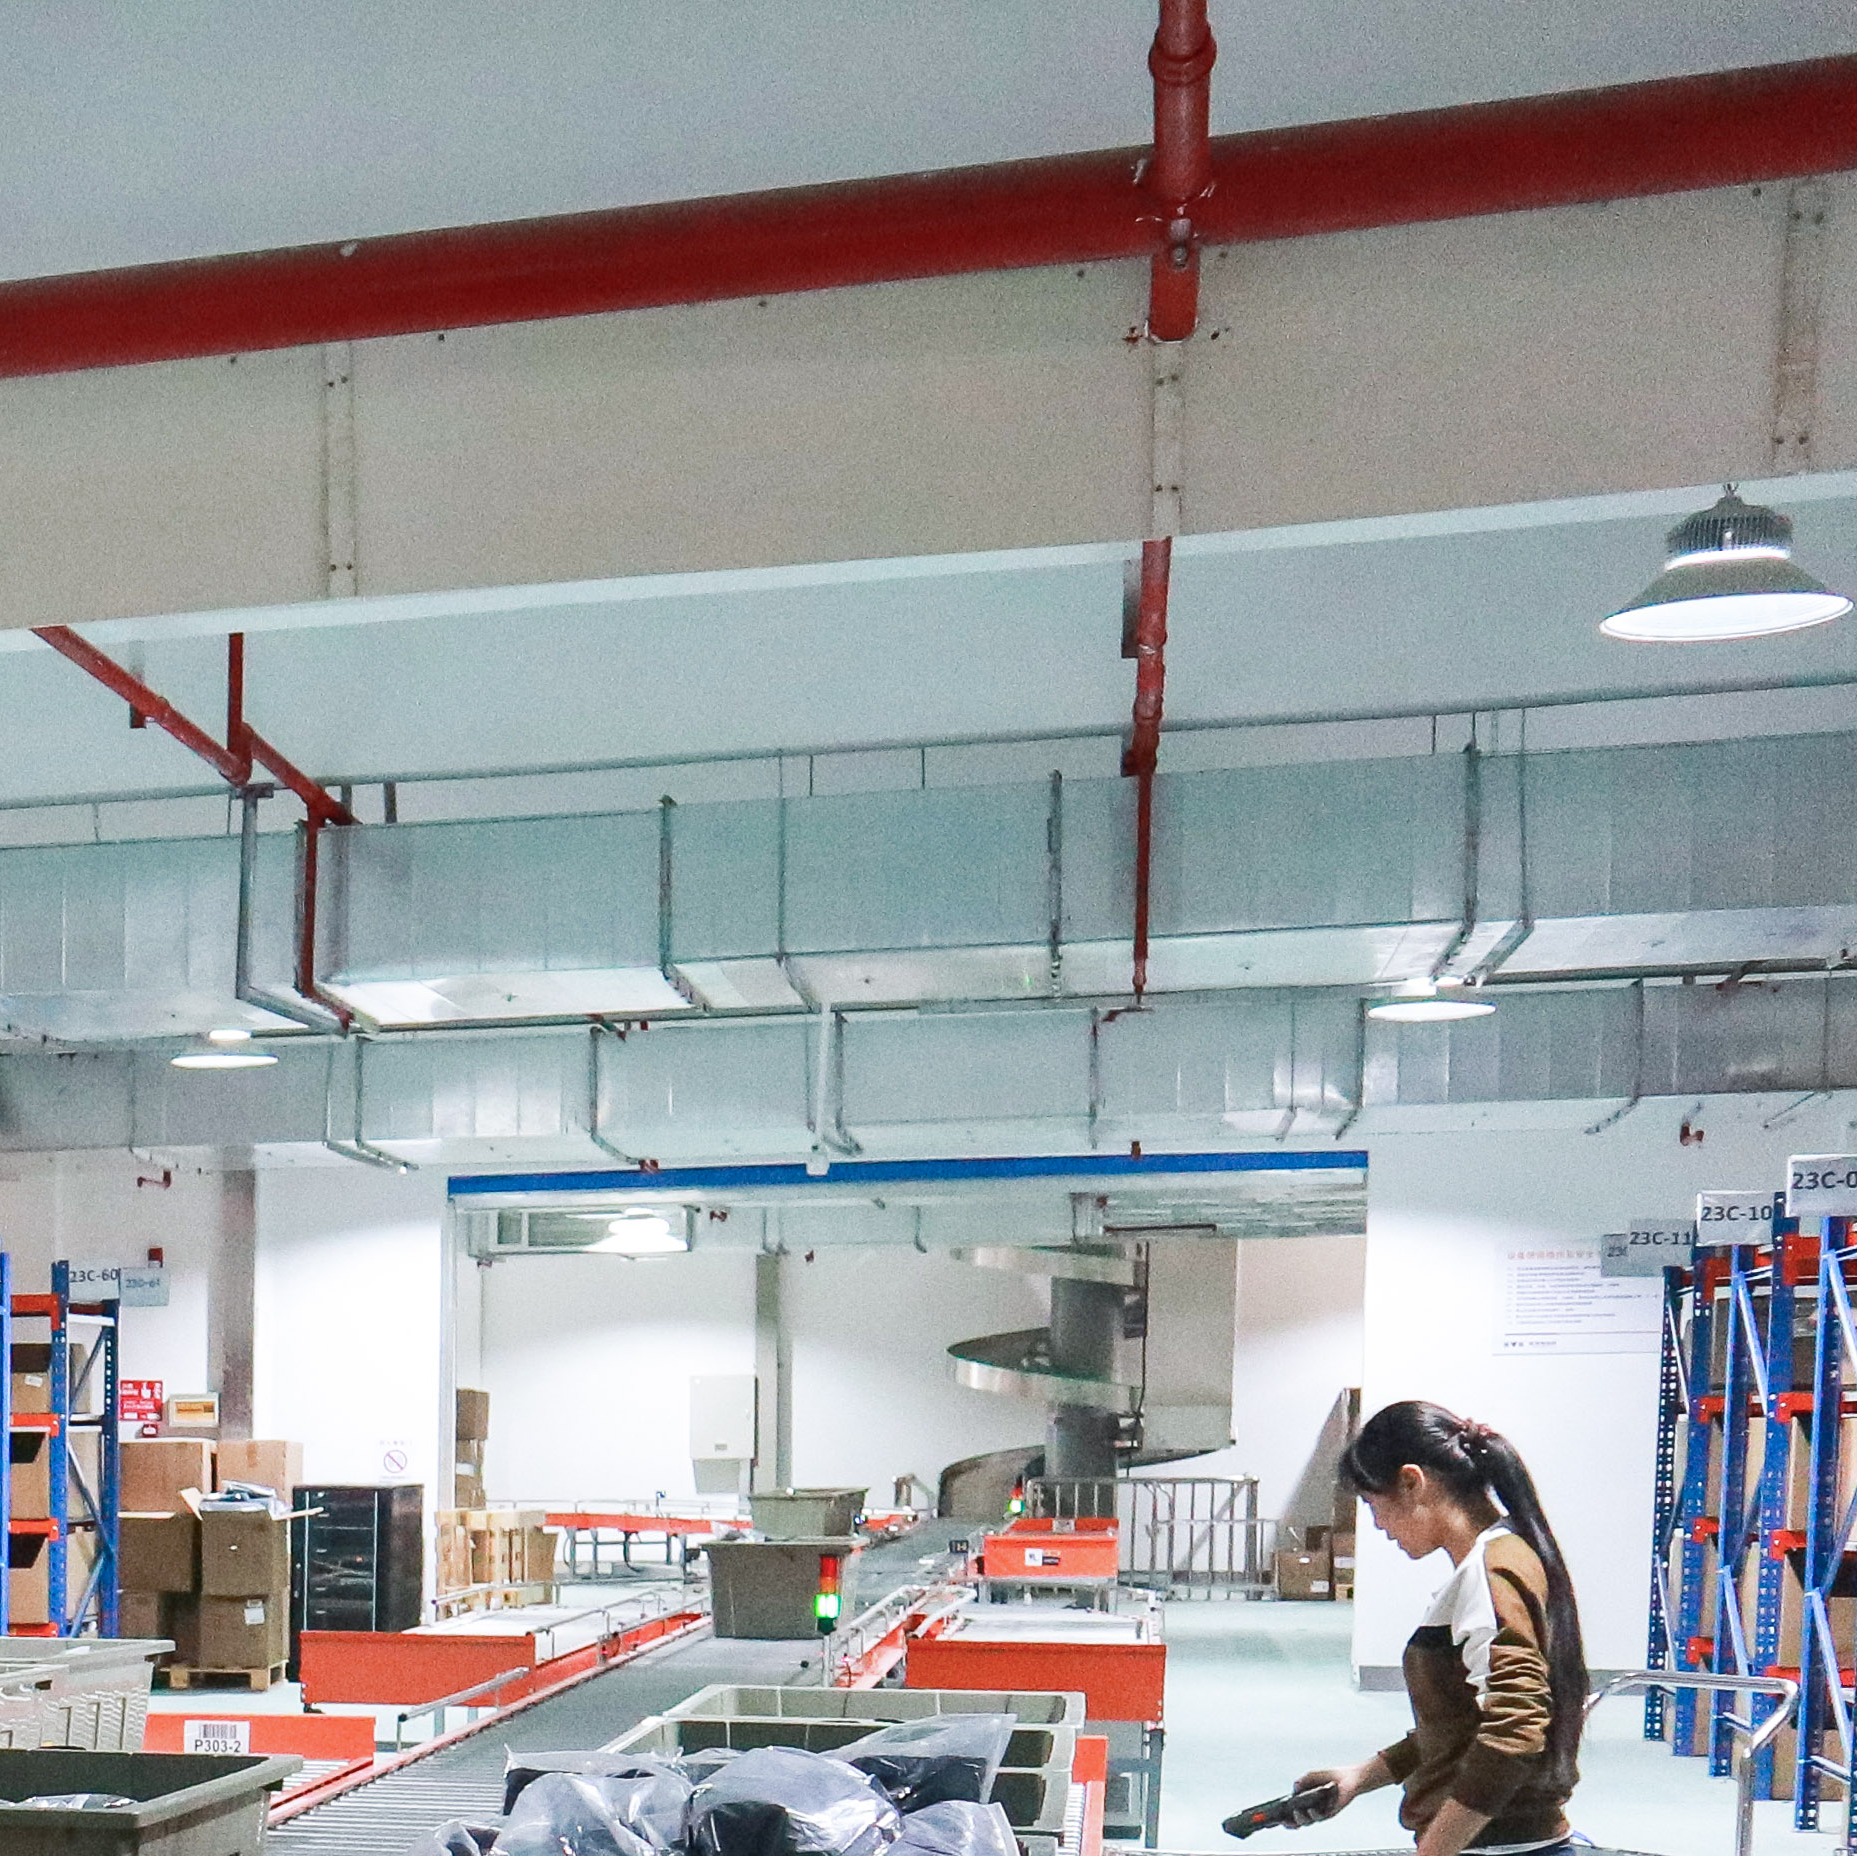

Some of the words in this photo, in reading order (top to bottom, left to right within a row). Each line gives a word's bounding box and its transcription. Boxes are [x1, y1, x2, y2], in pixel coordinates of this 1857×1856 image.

[1701, 1205, 1773, 1222] 23C-10
[69, 1268, 119, 1283] 23C-60
[194, 1739, 241, 1753] P303-2
